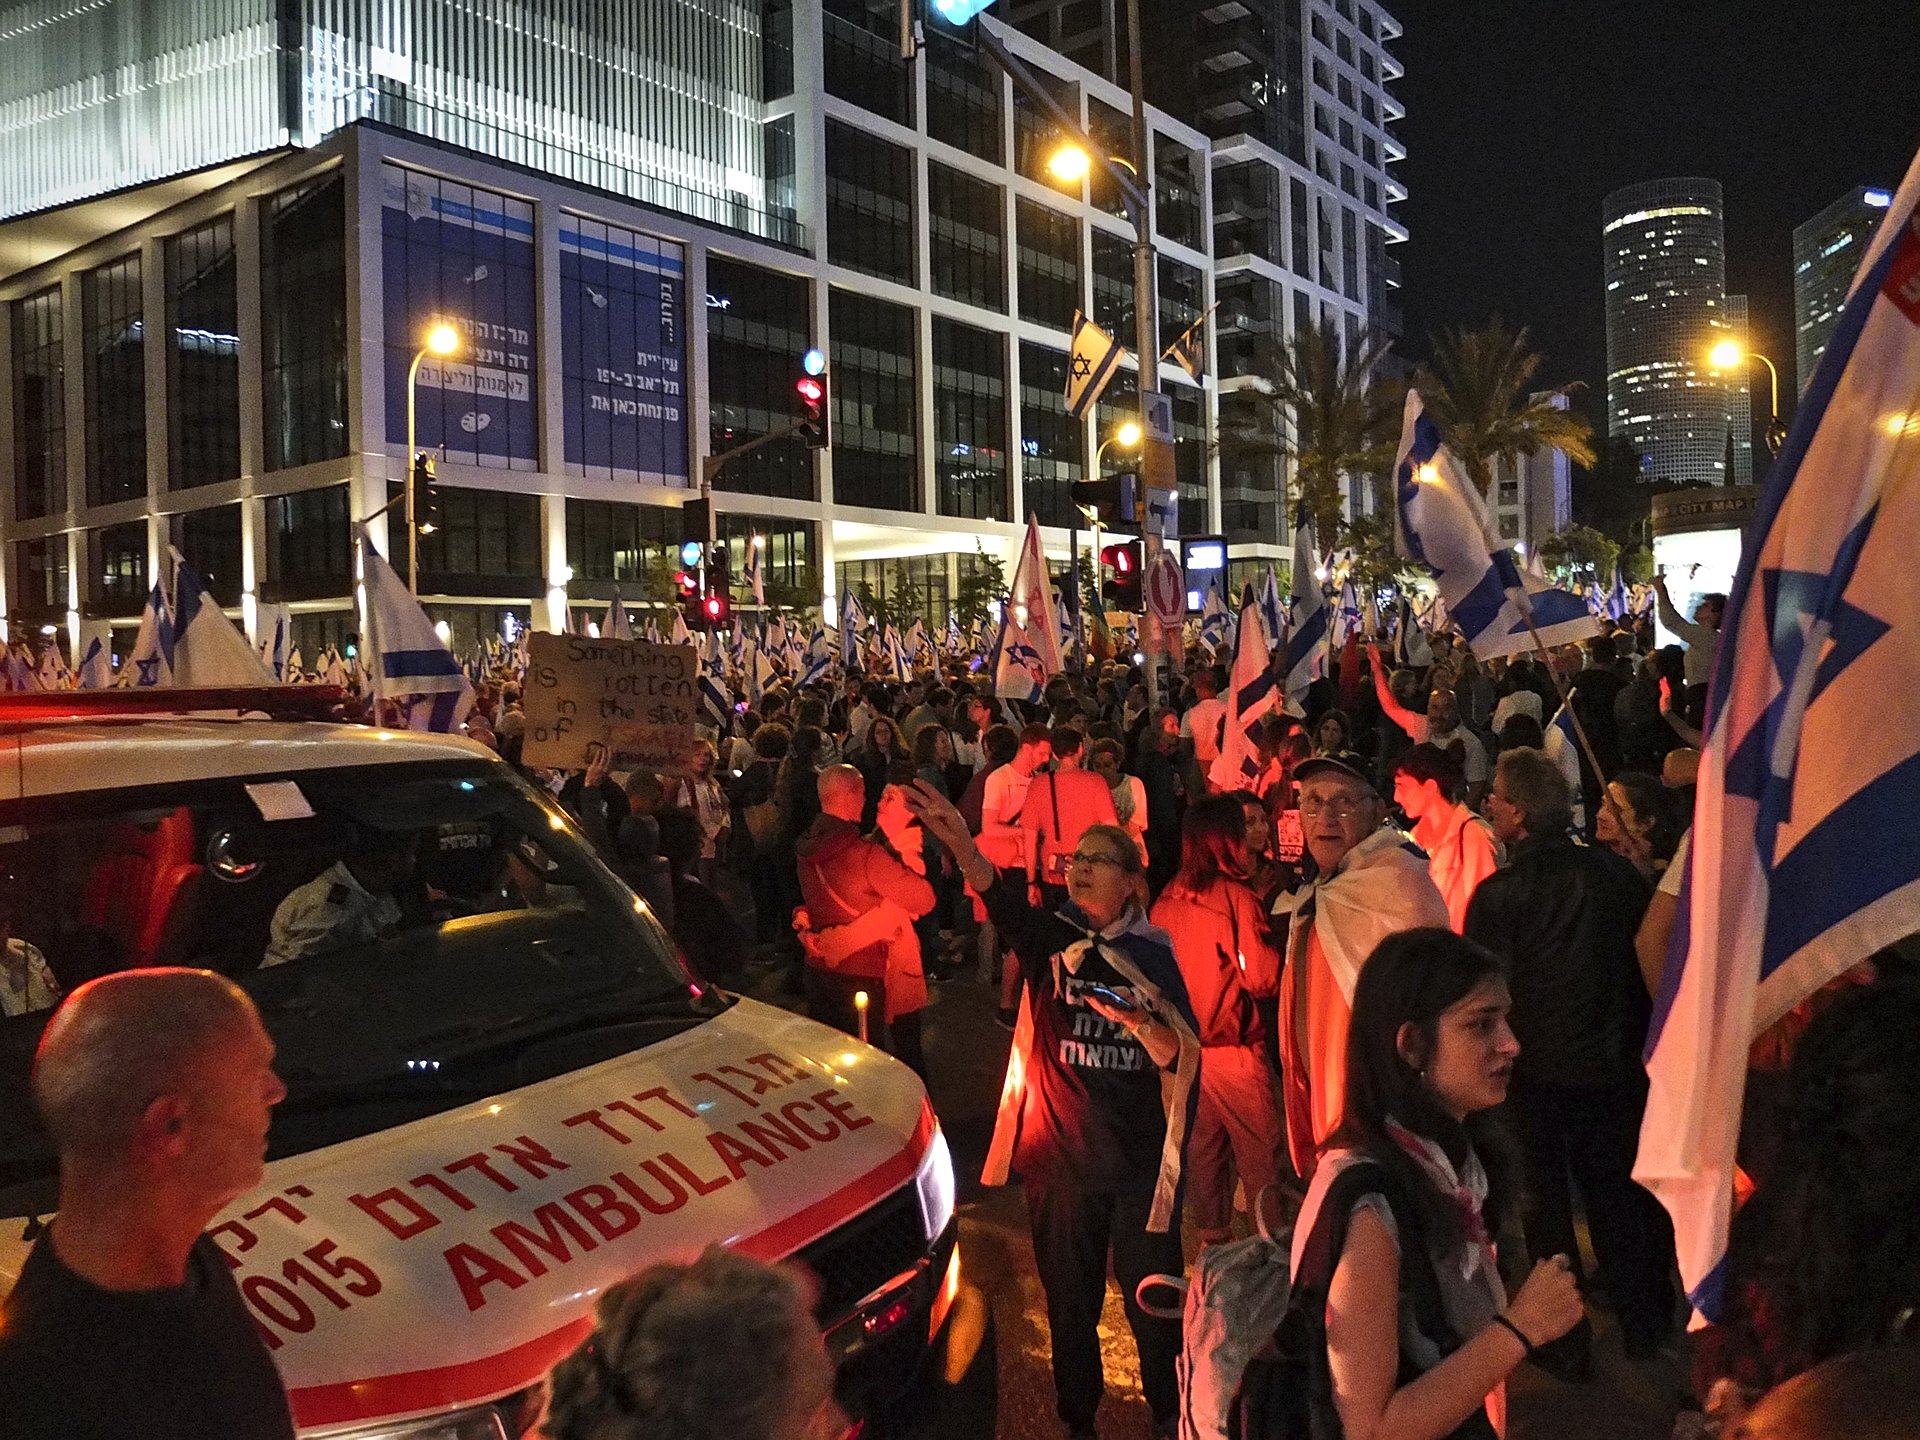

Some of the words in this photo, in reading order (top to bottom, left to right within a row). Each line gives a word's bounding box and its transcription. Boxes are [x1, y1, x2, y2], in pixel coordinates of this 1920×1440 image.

[508, 353, 529, 370] דה
[636, 351, 678, 373] עיריית
[421, 366, 472, 387] וליצרה
[476, 375, 523, 395] לאמנות
[590, 395, 610, 412] את
[612, 398, 637, 416] כאן
[637, 402, 679, 422] פותחת
[1680, 502, 1708, 514] CITY
[1712, 499, 1745, 512] MAP
[568, 637, 685, 681] Something
[534, 662, 558, 688] is
[604, 674, 693, 697] rotten
[557, 695, 577, 714] in
[600, 696, 635, 720] the
[534, 716, 573, 743] of
[692, 1052, 814, 1108] מגן
[561, 1086, 700, 1146] דוד
[346, 1134, 572, 1240] אדום
[442, 1089, 874, 1312] AMBULANCE
[207, 1184, 315, 1270] ירק
[241, 1237, 383, 1350] 015
